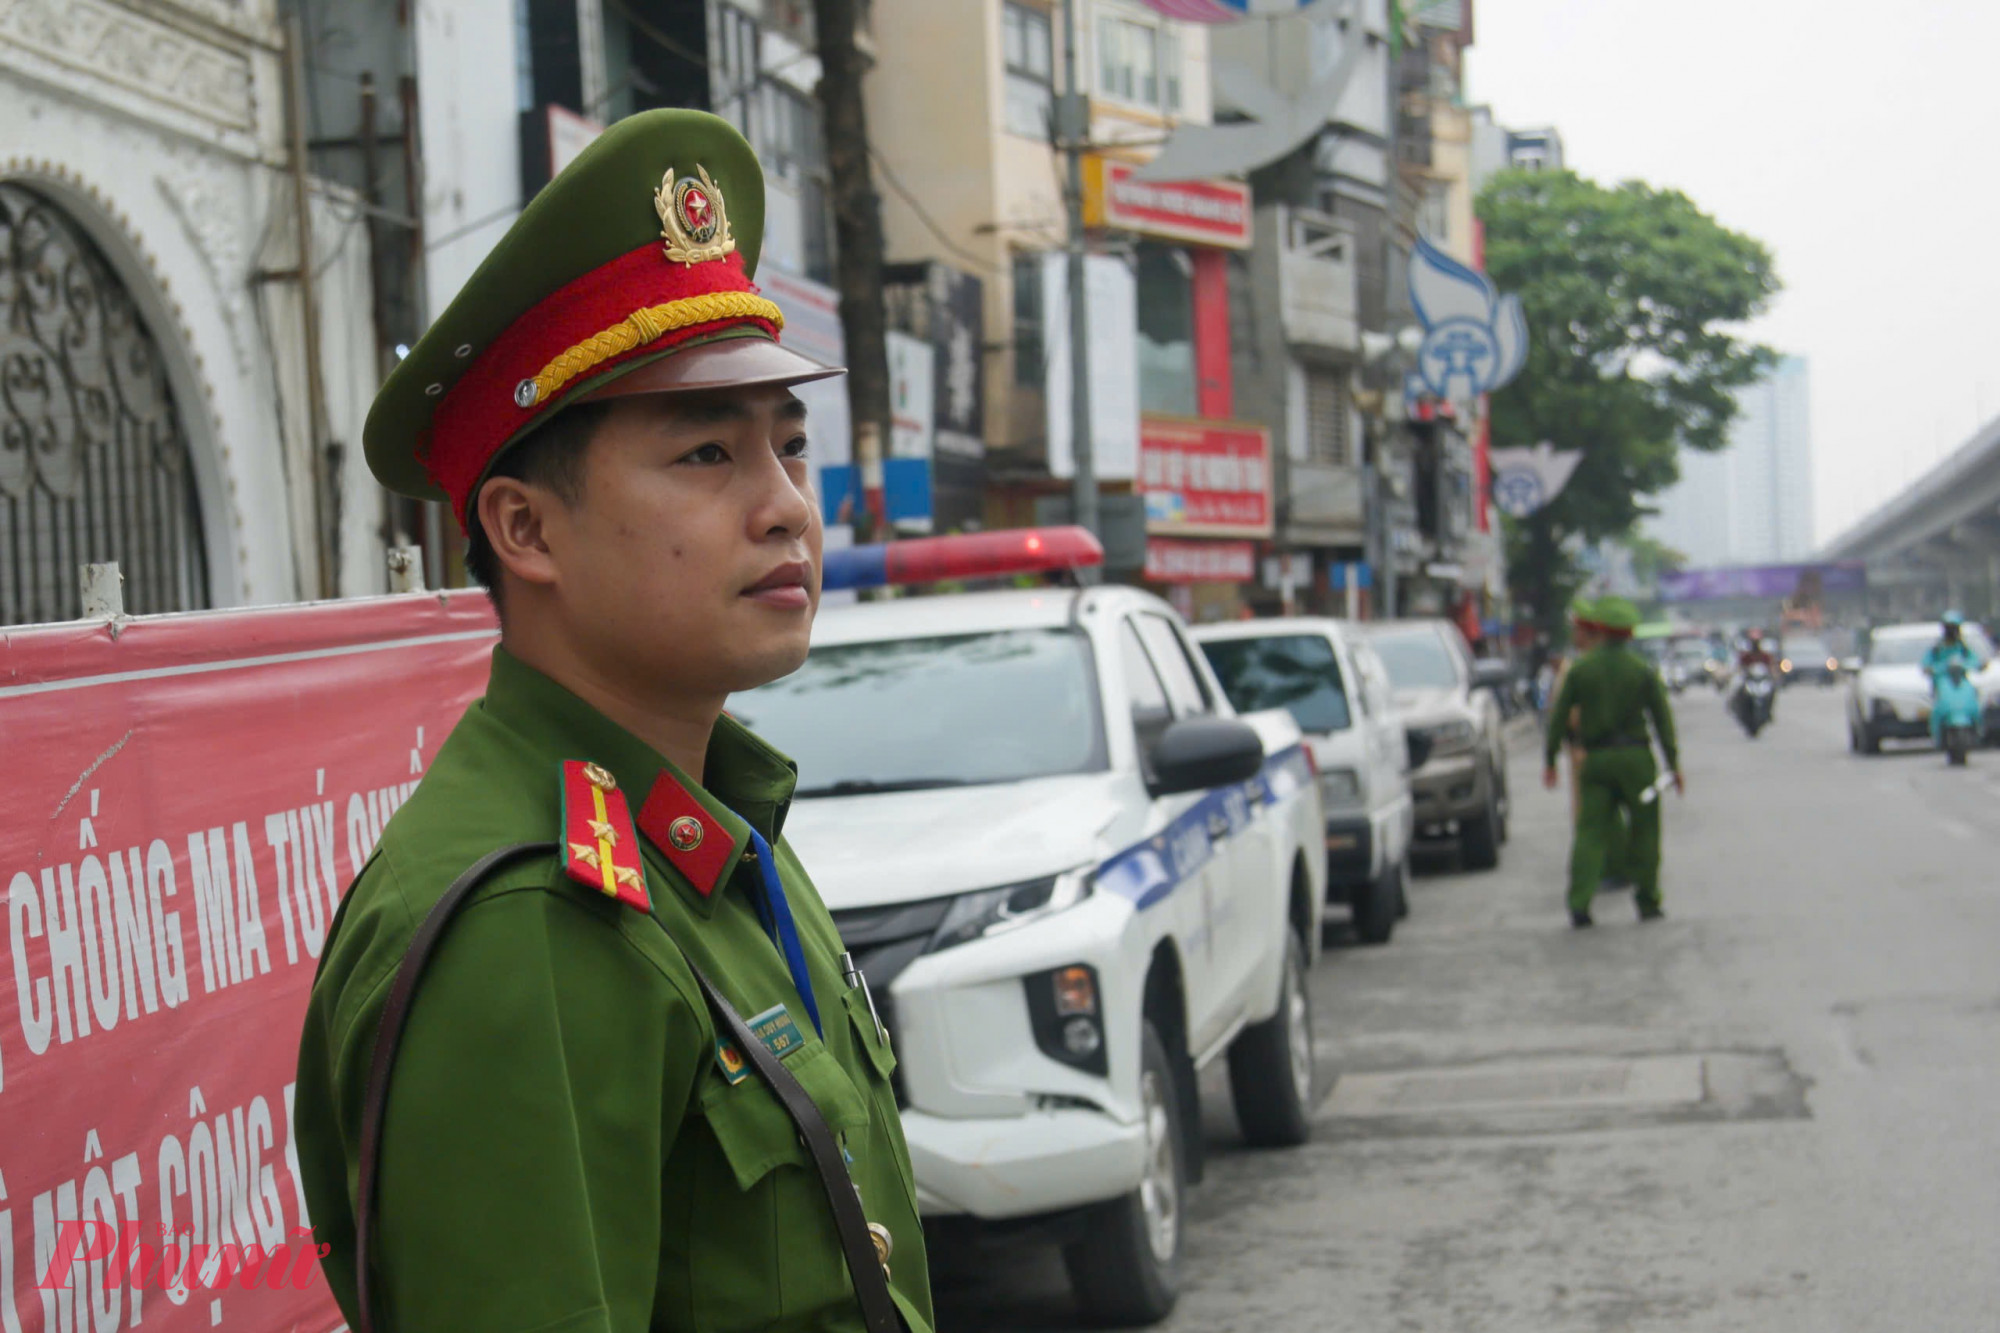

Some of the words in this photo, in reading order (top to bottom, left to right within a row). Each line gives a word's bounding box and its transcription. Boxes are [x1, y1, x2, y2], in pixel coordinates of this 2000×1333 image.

[9, 789, 189, 1055] CHỐNG
[188, 821, 271, 993] MA
[265, 768, 339, 965] TUÝ
[158, 1085, 286, 1327] CỘNG
